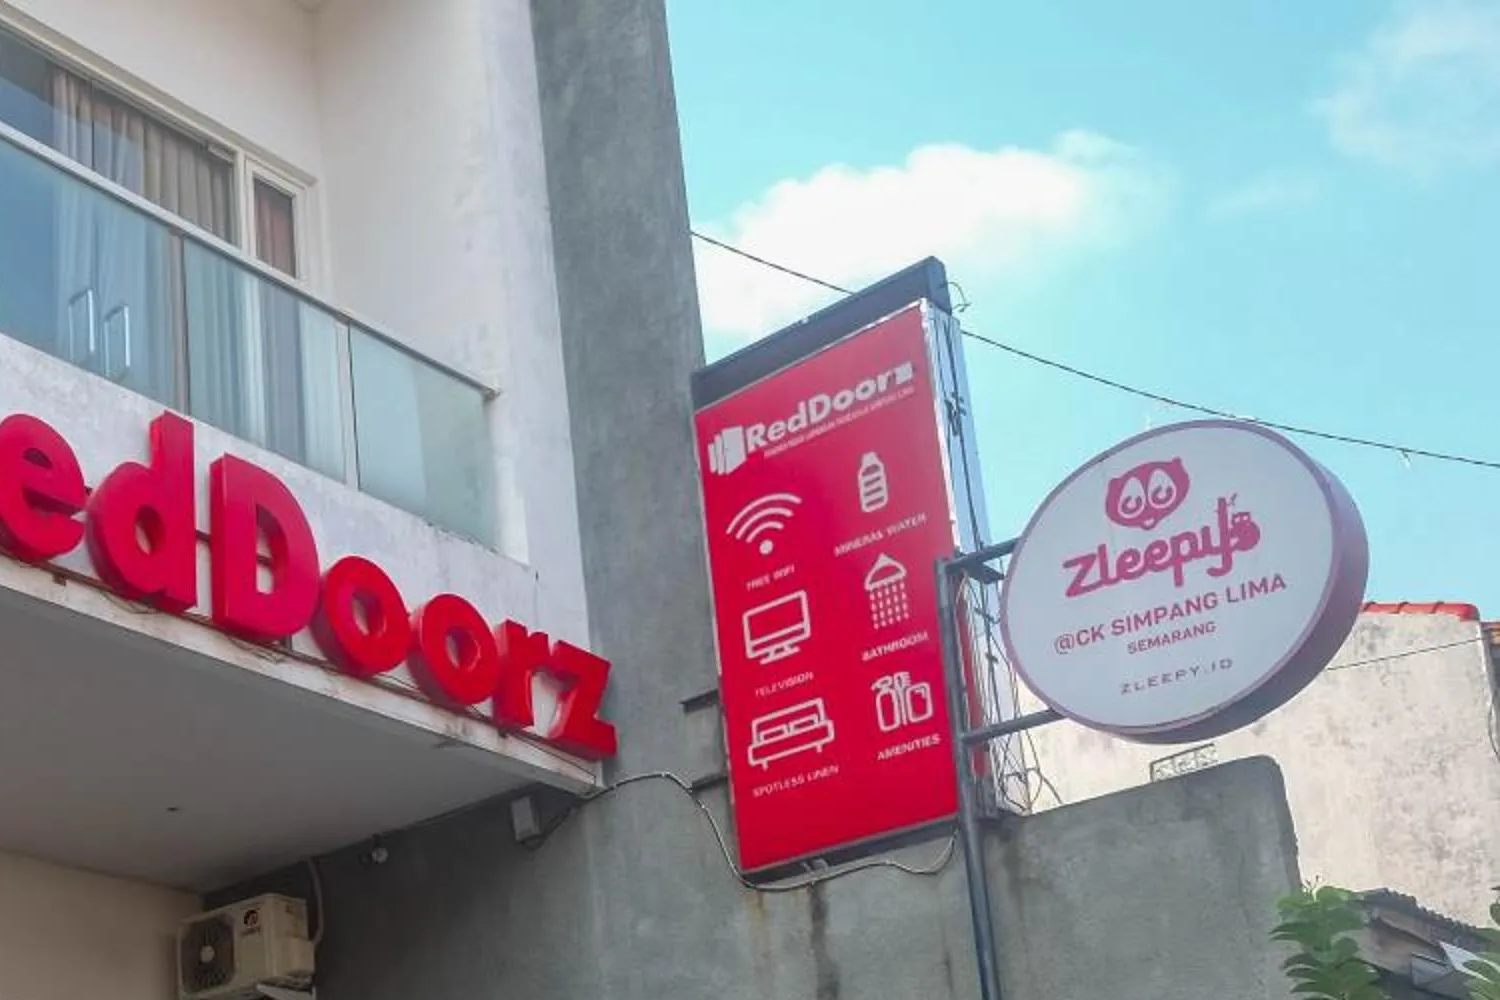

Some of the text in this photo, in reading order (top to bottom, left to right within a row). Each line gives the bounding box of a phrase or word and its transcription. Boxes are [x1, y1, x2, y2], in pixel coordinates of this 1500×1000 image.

[886, 512, 928, 537] WATER
[1062, 495, 1245, 598] Zleepy
[1054, 573, 1287, 655] @CK SIMPANG LIMA
[861, 630, 929, 661] BATHROOM
[1126, 620, 1217, 655] SEMARANG
[754, 672, 815, 698] TELEVISION
[877, 733, 942, 761] AMENITIES
[752, 764, 840, 798] SPOTLESS LINEN
